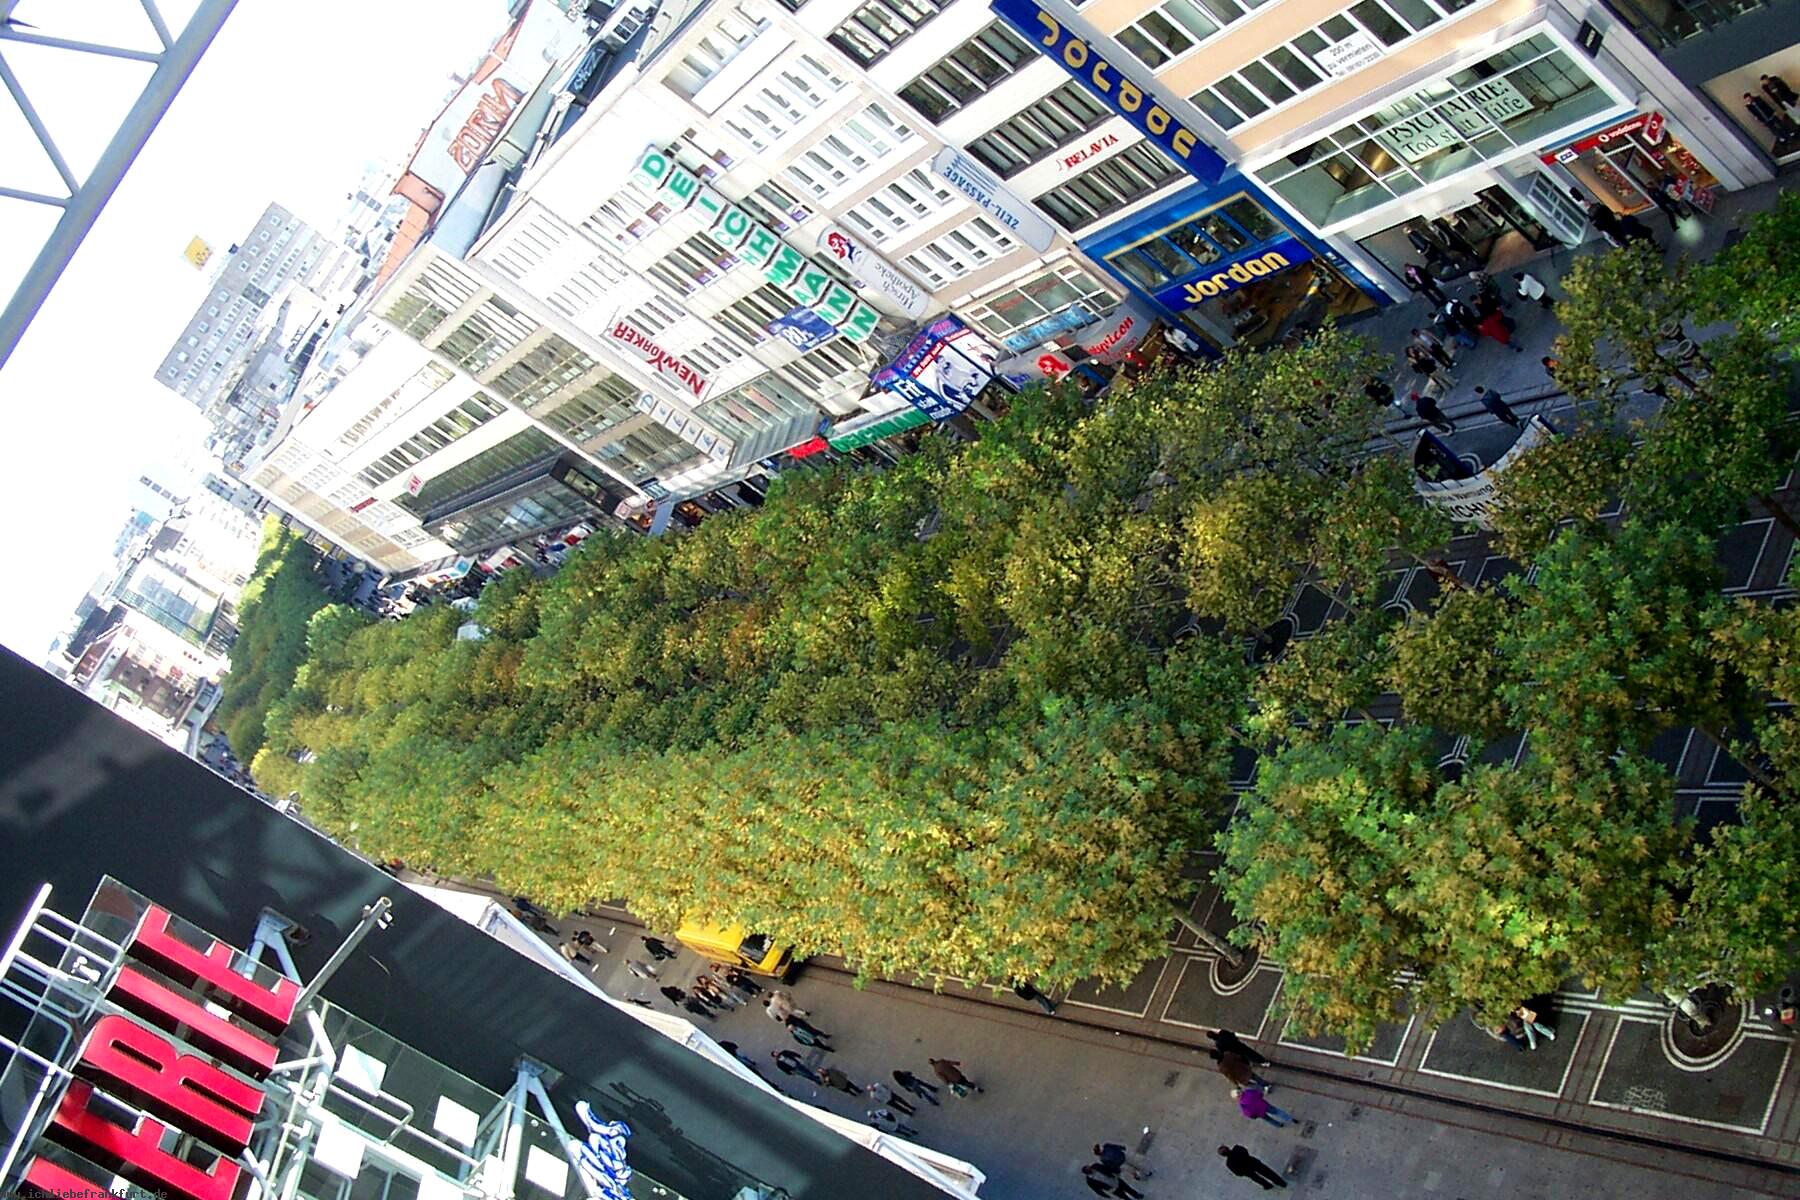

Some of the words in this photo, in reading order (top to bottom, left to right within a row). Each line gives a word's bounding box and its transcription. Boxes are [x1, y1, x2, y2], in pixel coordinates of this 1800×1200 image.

[1036, 12, 1197, 159] Jordan
[1064, 135, 1119, 168] BELAVIA
[1402, 135, 1436, 157] Tod
[943, 167, 1019, 231] ZEIL-PASSAGE
[641, 152, 878, 334] DEICHMANN
[1184, 251, 1291, 305] Jordan
